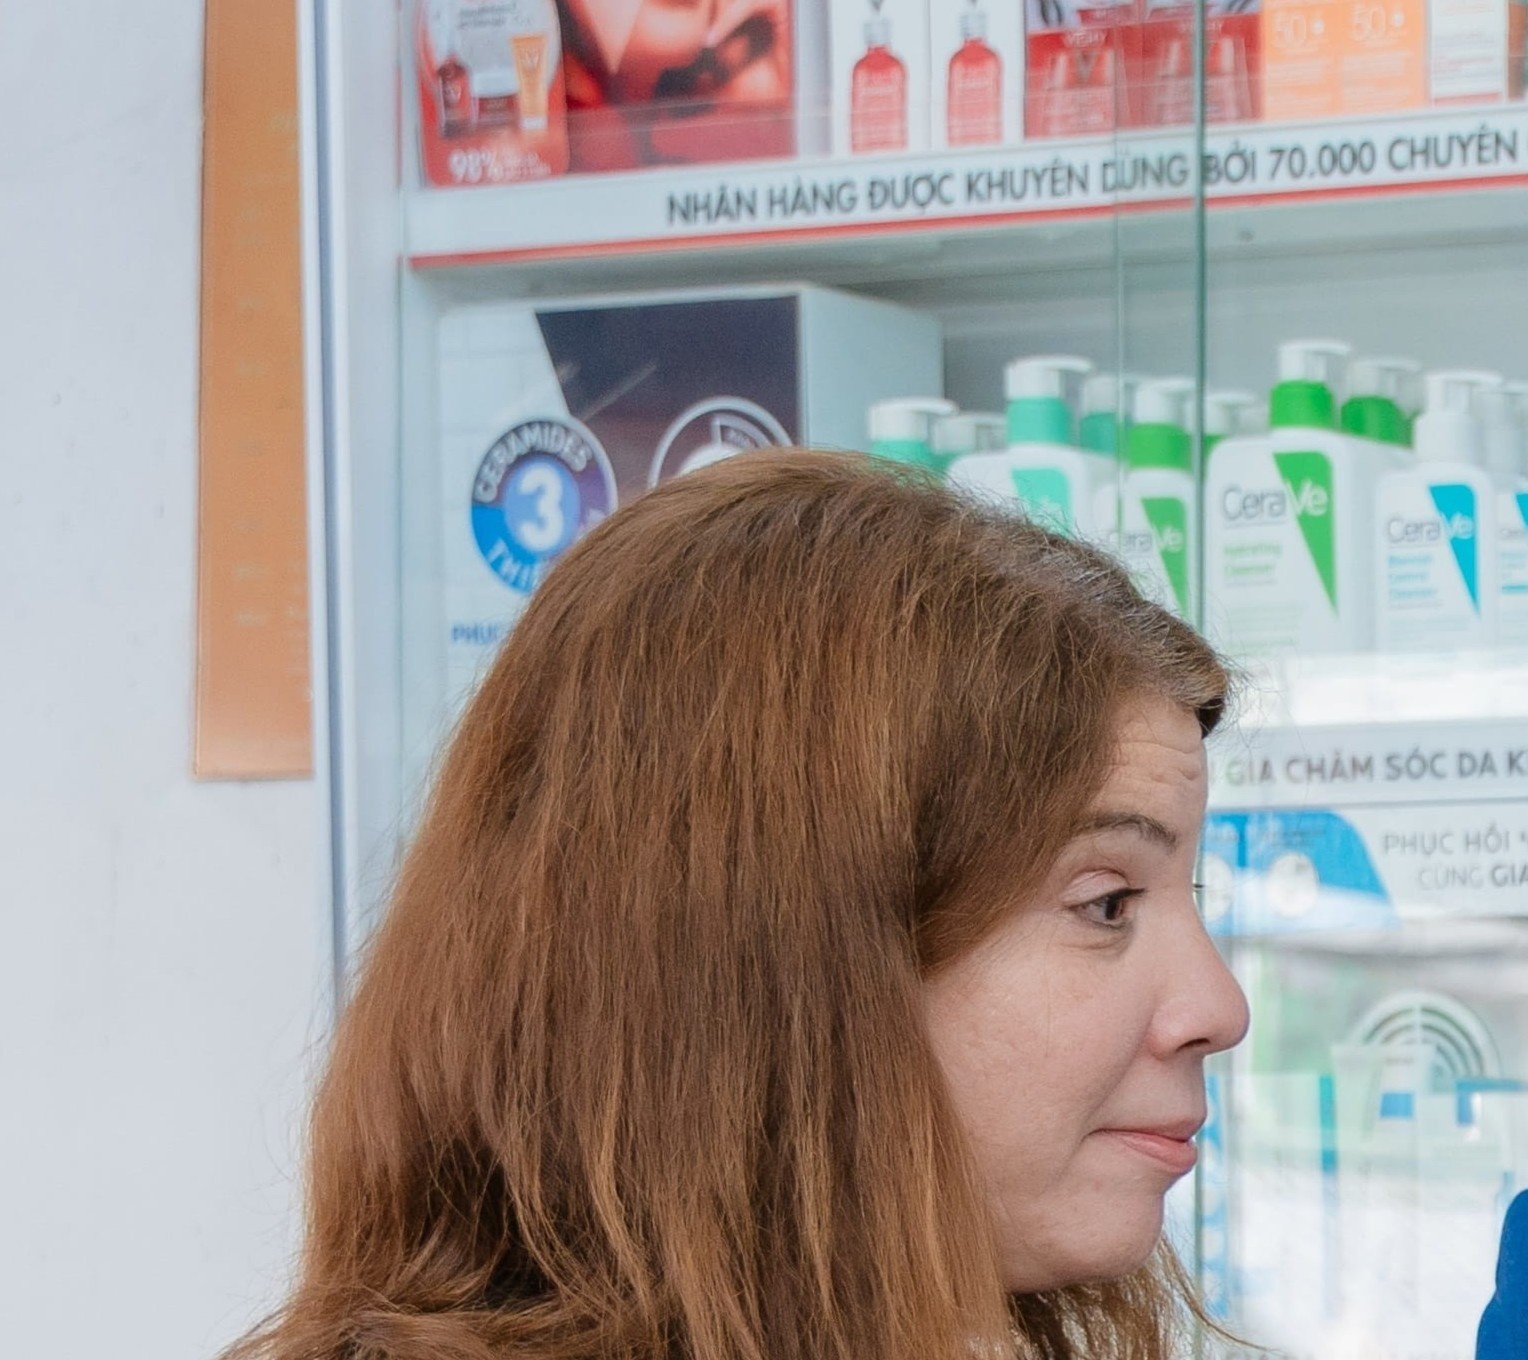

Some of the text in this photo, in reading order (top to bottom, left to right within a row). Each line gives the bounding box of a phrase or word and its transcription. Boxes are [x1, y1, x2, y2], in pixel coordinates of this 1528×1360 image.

[869, 170, 955, 216] ĐƯỢC
[1269, 139, 1377, 181] 70.000
[519, 463, 565, 551] 3
[1386, 742, 1448, 780] SÓC
[1457, 750, 1498, 779] DA
